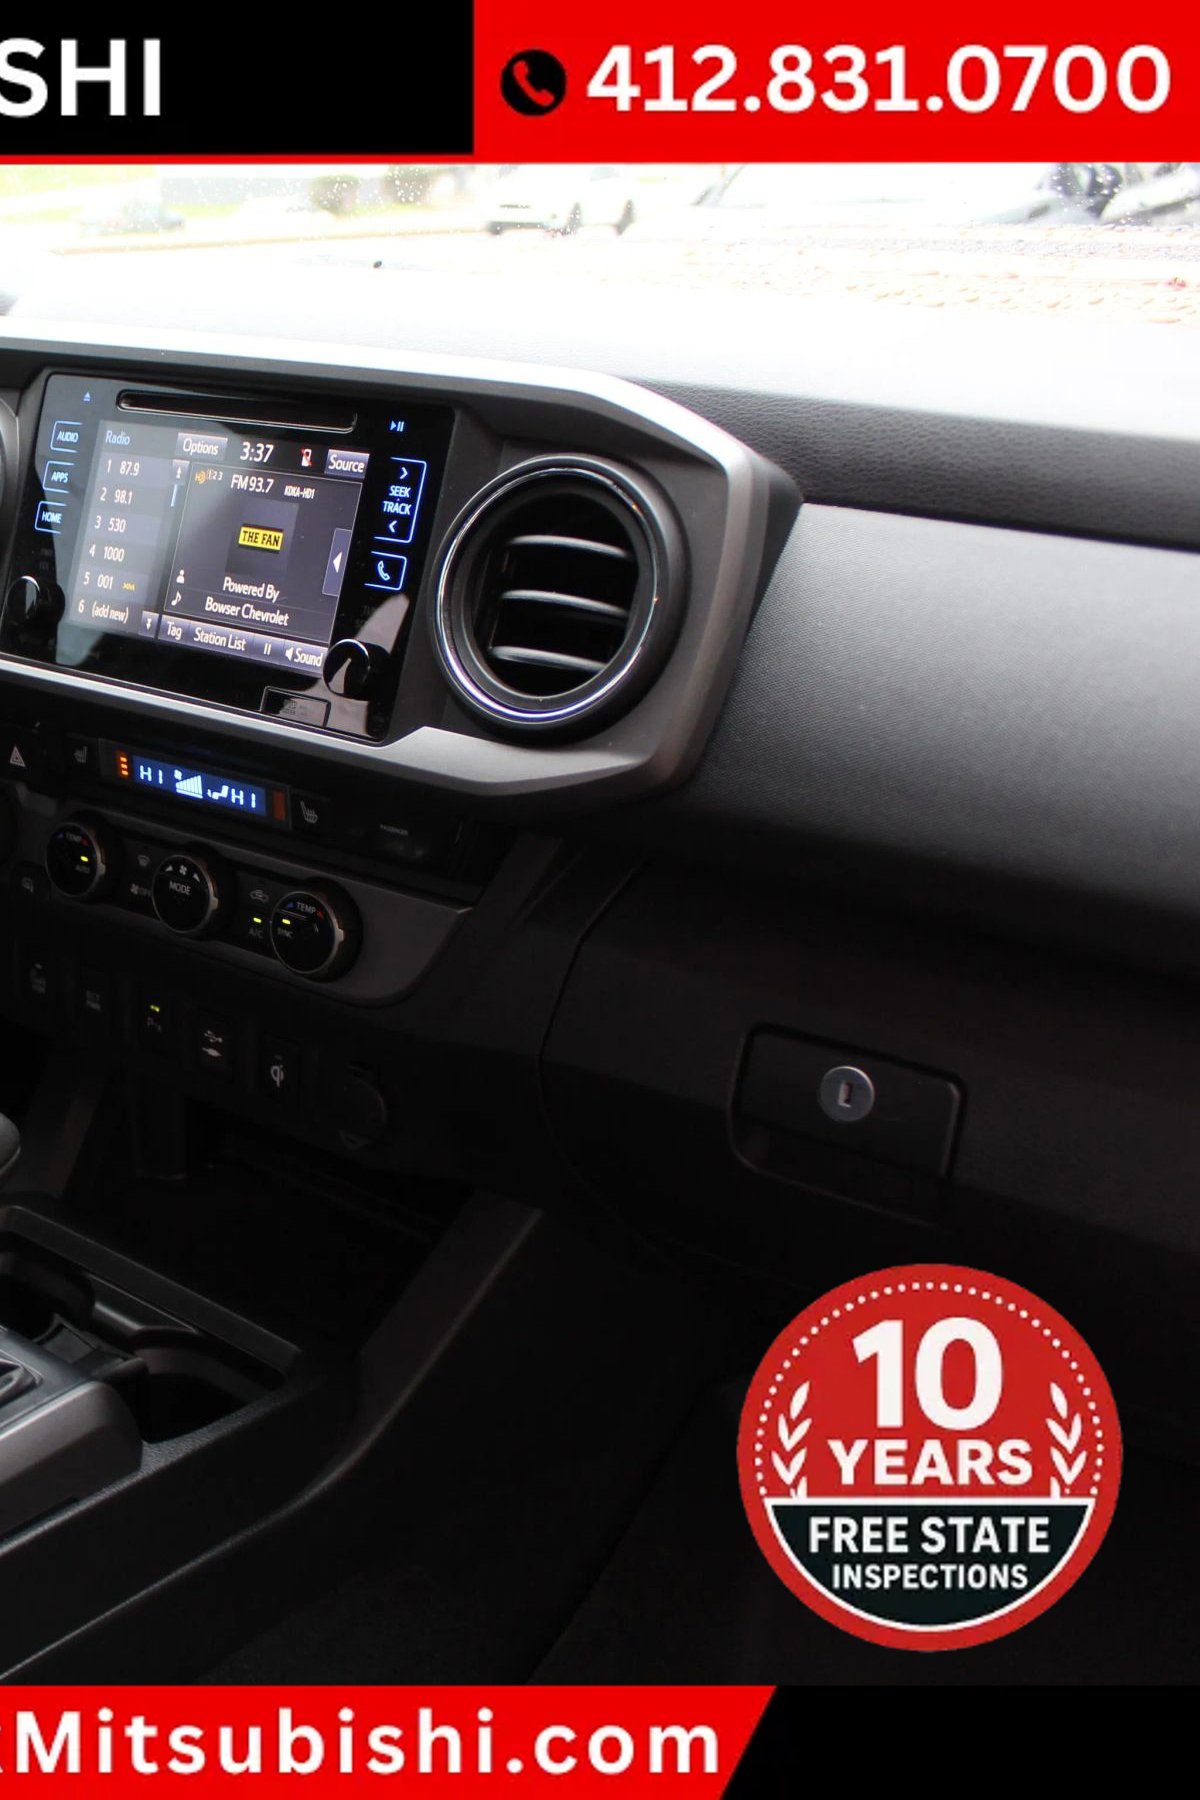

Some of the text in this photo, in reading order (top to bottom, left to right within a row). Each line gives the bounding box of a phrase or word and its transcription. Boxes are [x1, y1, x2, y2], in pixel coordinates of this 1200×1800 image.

[57, 431, 78, 443] AUDIO
[105, 430, 130, 445] Radio
[182, 438, 219, 456] Options
[240, 441, 275, 463] 3:37
[107, 459, 140, 476] 1 87.9
[328, 454, 365, 473] Source
[51, 471, 69, 484] APPS
[100, 487, 133, 505] 2 98.1
[284, 484, 316, 500] KDKA-HD1
[388, 484, 411, 498] SEEK
[383, 500, 412, 515] TRACK
[41, 510, 63, 524] HOME
[94, 515, 126, 534] 3 530
[242, 530, 280, 547] THE FAN
[89, 544, 125, 562] 4 1000
[83, 571, 90, 586] 5
[98, 574, 114, 590] 001
[222, 576, 280, 604] Powered By
[78, 599, 129, 624] 6 (add new)
[205, 596, 290, 626] Bowser Chevrolet
[167, 622, 182, 641] Tag
[194, 626, 247, 652] Station List
[294, 648, 324, 668] Sound
[169, 880, 192, 897] MODE
[296, 902, 316, 915] TEMP
